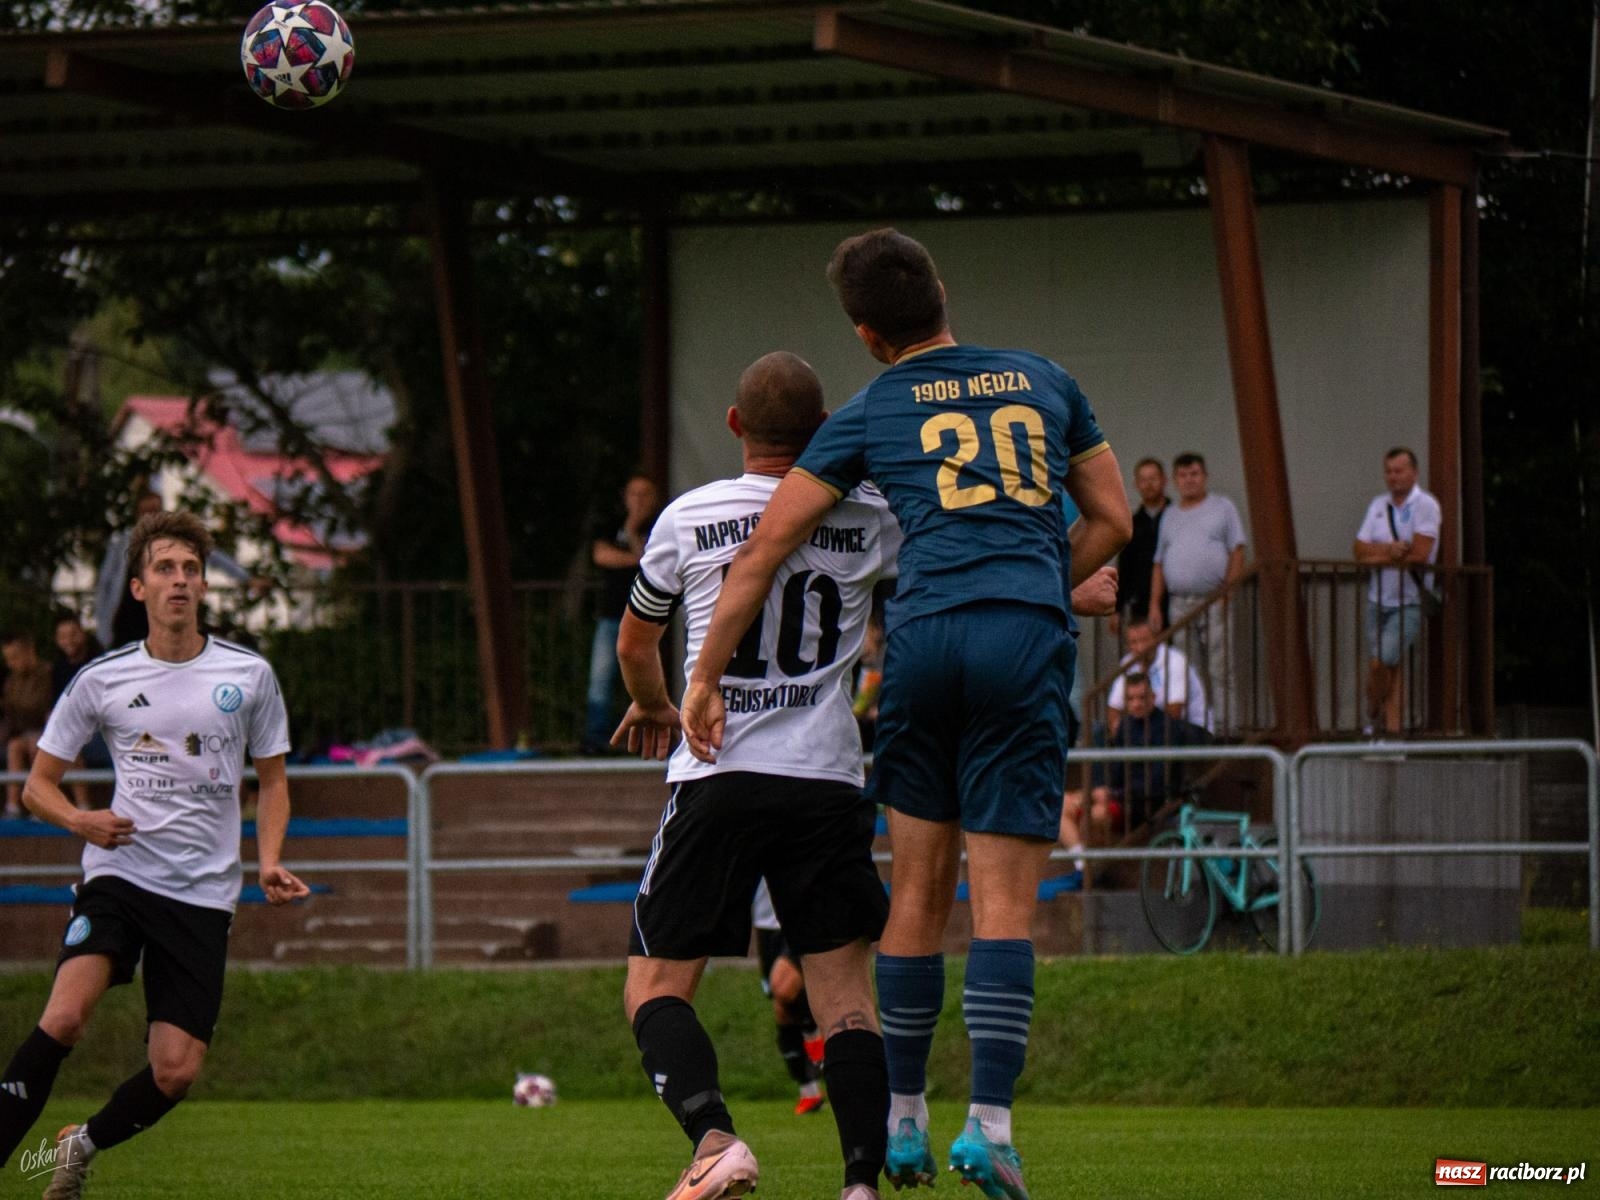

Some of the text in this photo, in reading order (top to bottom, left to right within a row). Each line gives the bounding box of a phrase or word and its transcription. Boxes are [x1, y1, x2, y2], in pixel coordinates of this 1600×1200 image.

[911, 372, 1031, 402] 1908 NĘDZA
[920, 404, 1052, 511] 20
[694, 512, 763, 551] NAPRZÓ
[720, 683, 823, 713] EGUSTATORZY
